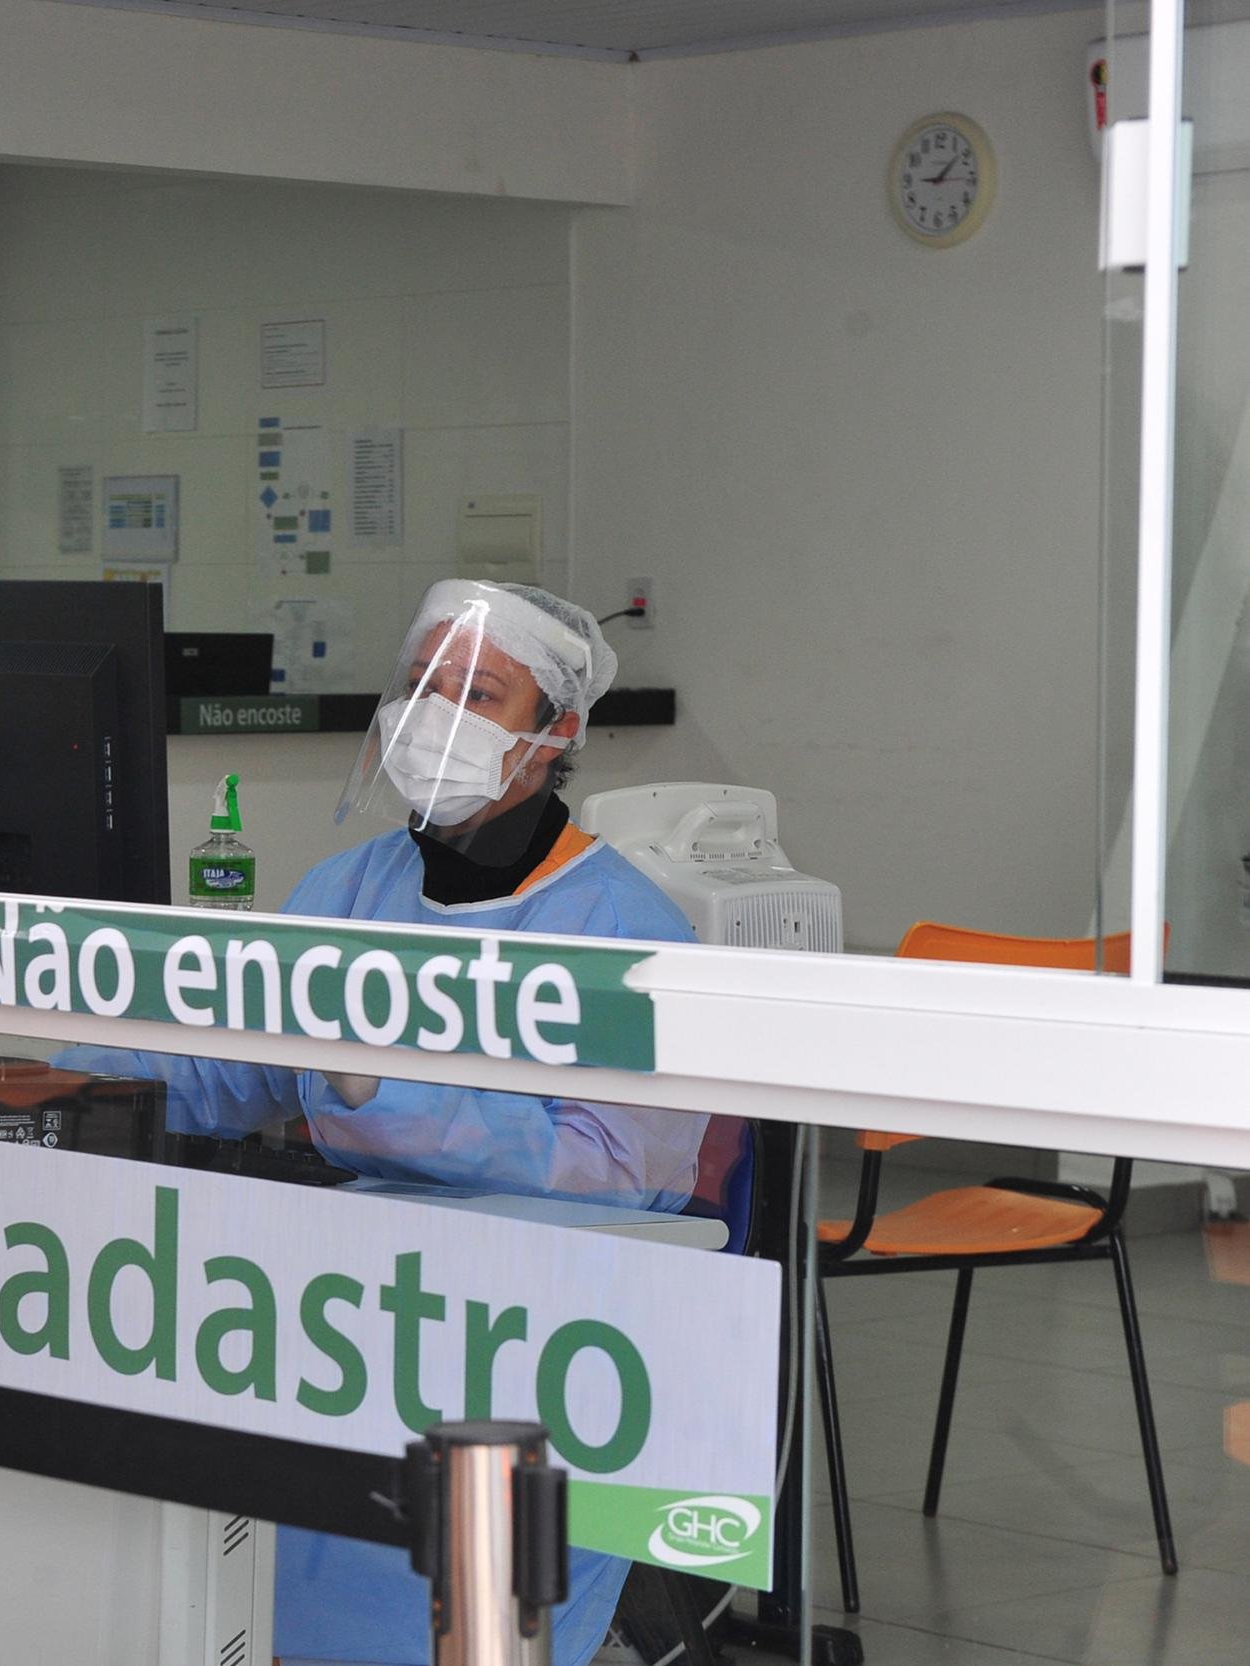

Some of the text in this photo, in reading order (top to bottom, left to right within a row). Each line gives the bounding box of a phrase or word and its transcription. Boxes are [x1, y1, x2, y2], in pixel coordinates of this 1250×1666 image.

[200, 703, 303, 726] Não encoste
[163, 934, 581, 1066] encoste
[667, 1507, 741, 1548] GHC
